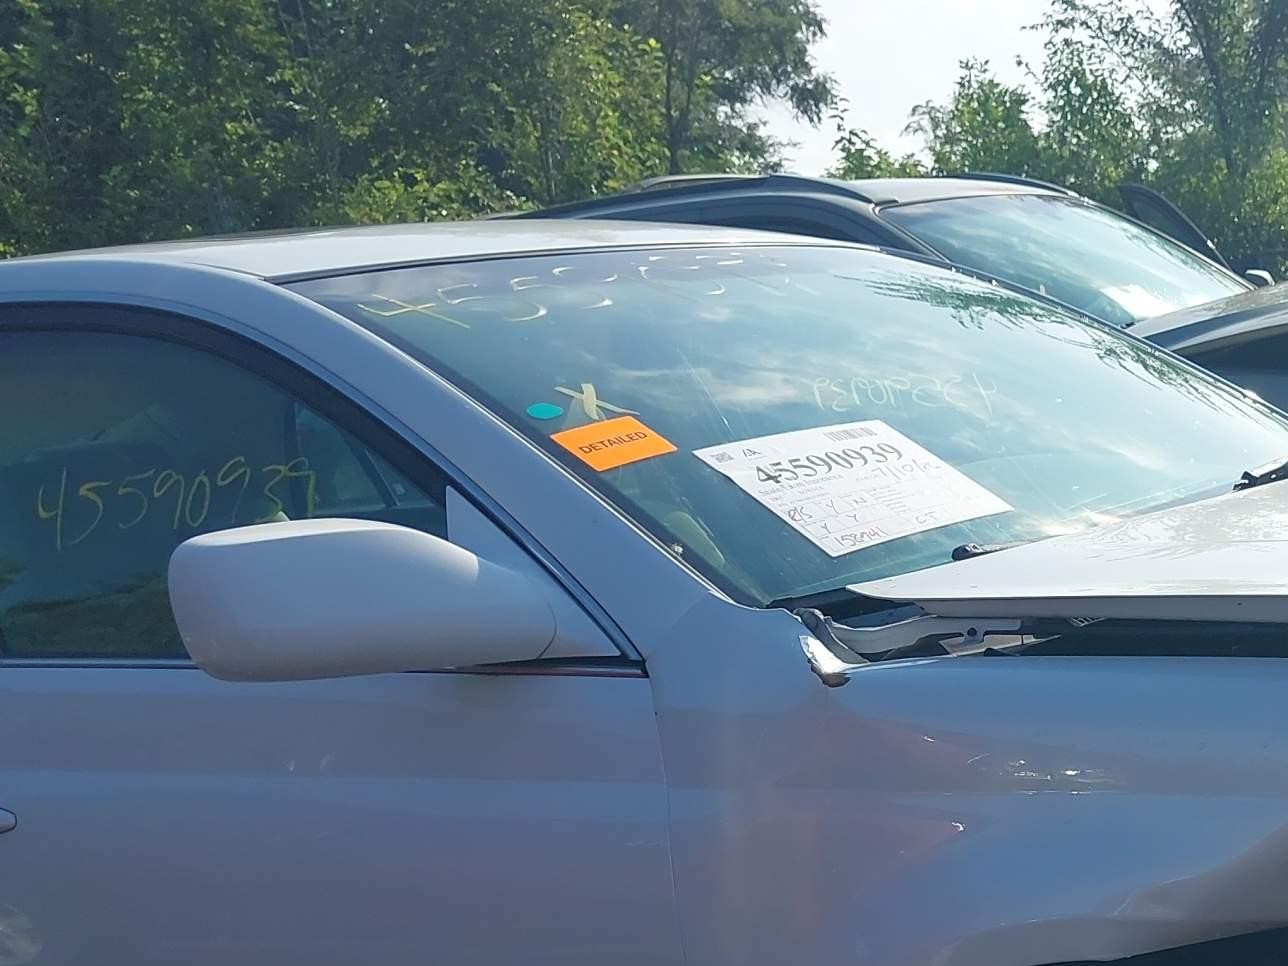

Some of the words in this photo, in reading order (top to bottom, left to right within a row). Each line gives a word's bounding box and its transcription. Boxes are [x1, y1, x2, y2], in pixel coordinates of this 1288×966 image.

[578, 431, 648, 454] DETAILED
[756, 442, 903, 484] 45590939
[37, 456, 320, 550] 45590939
